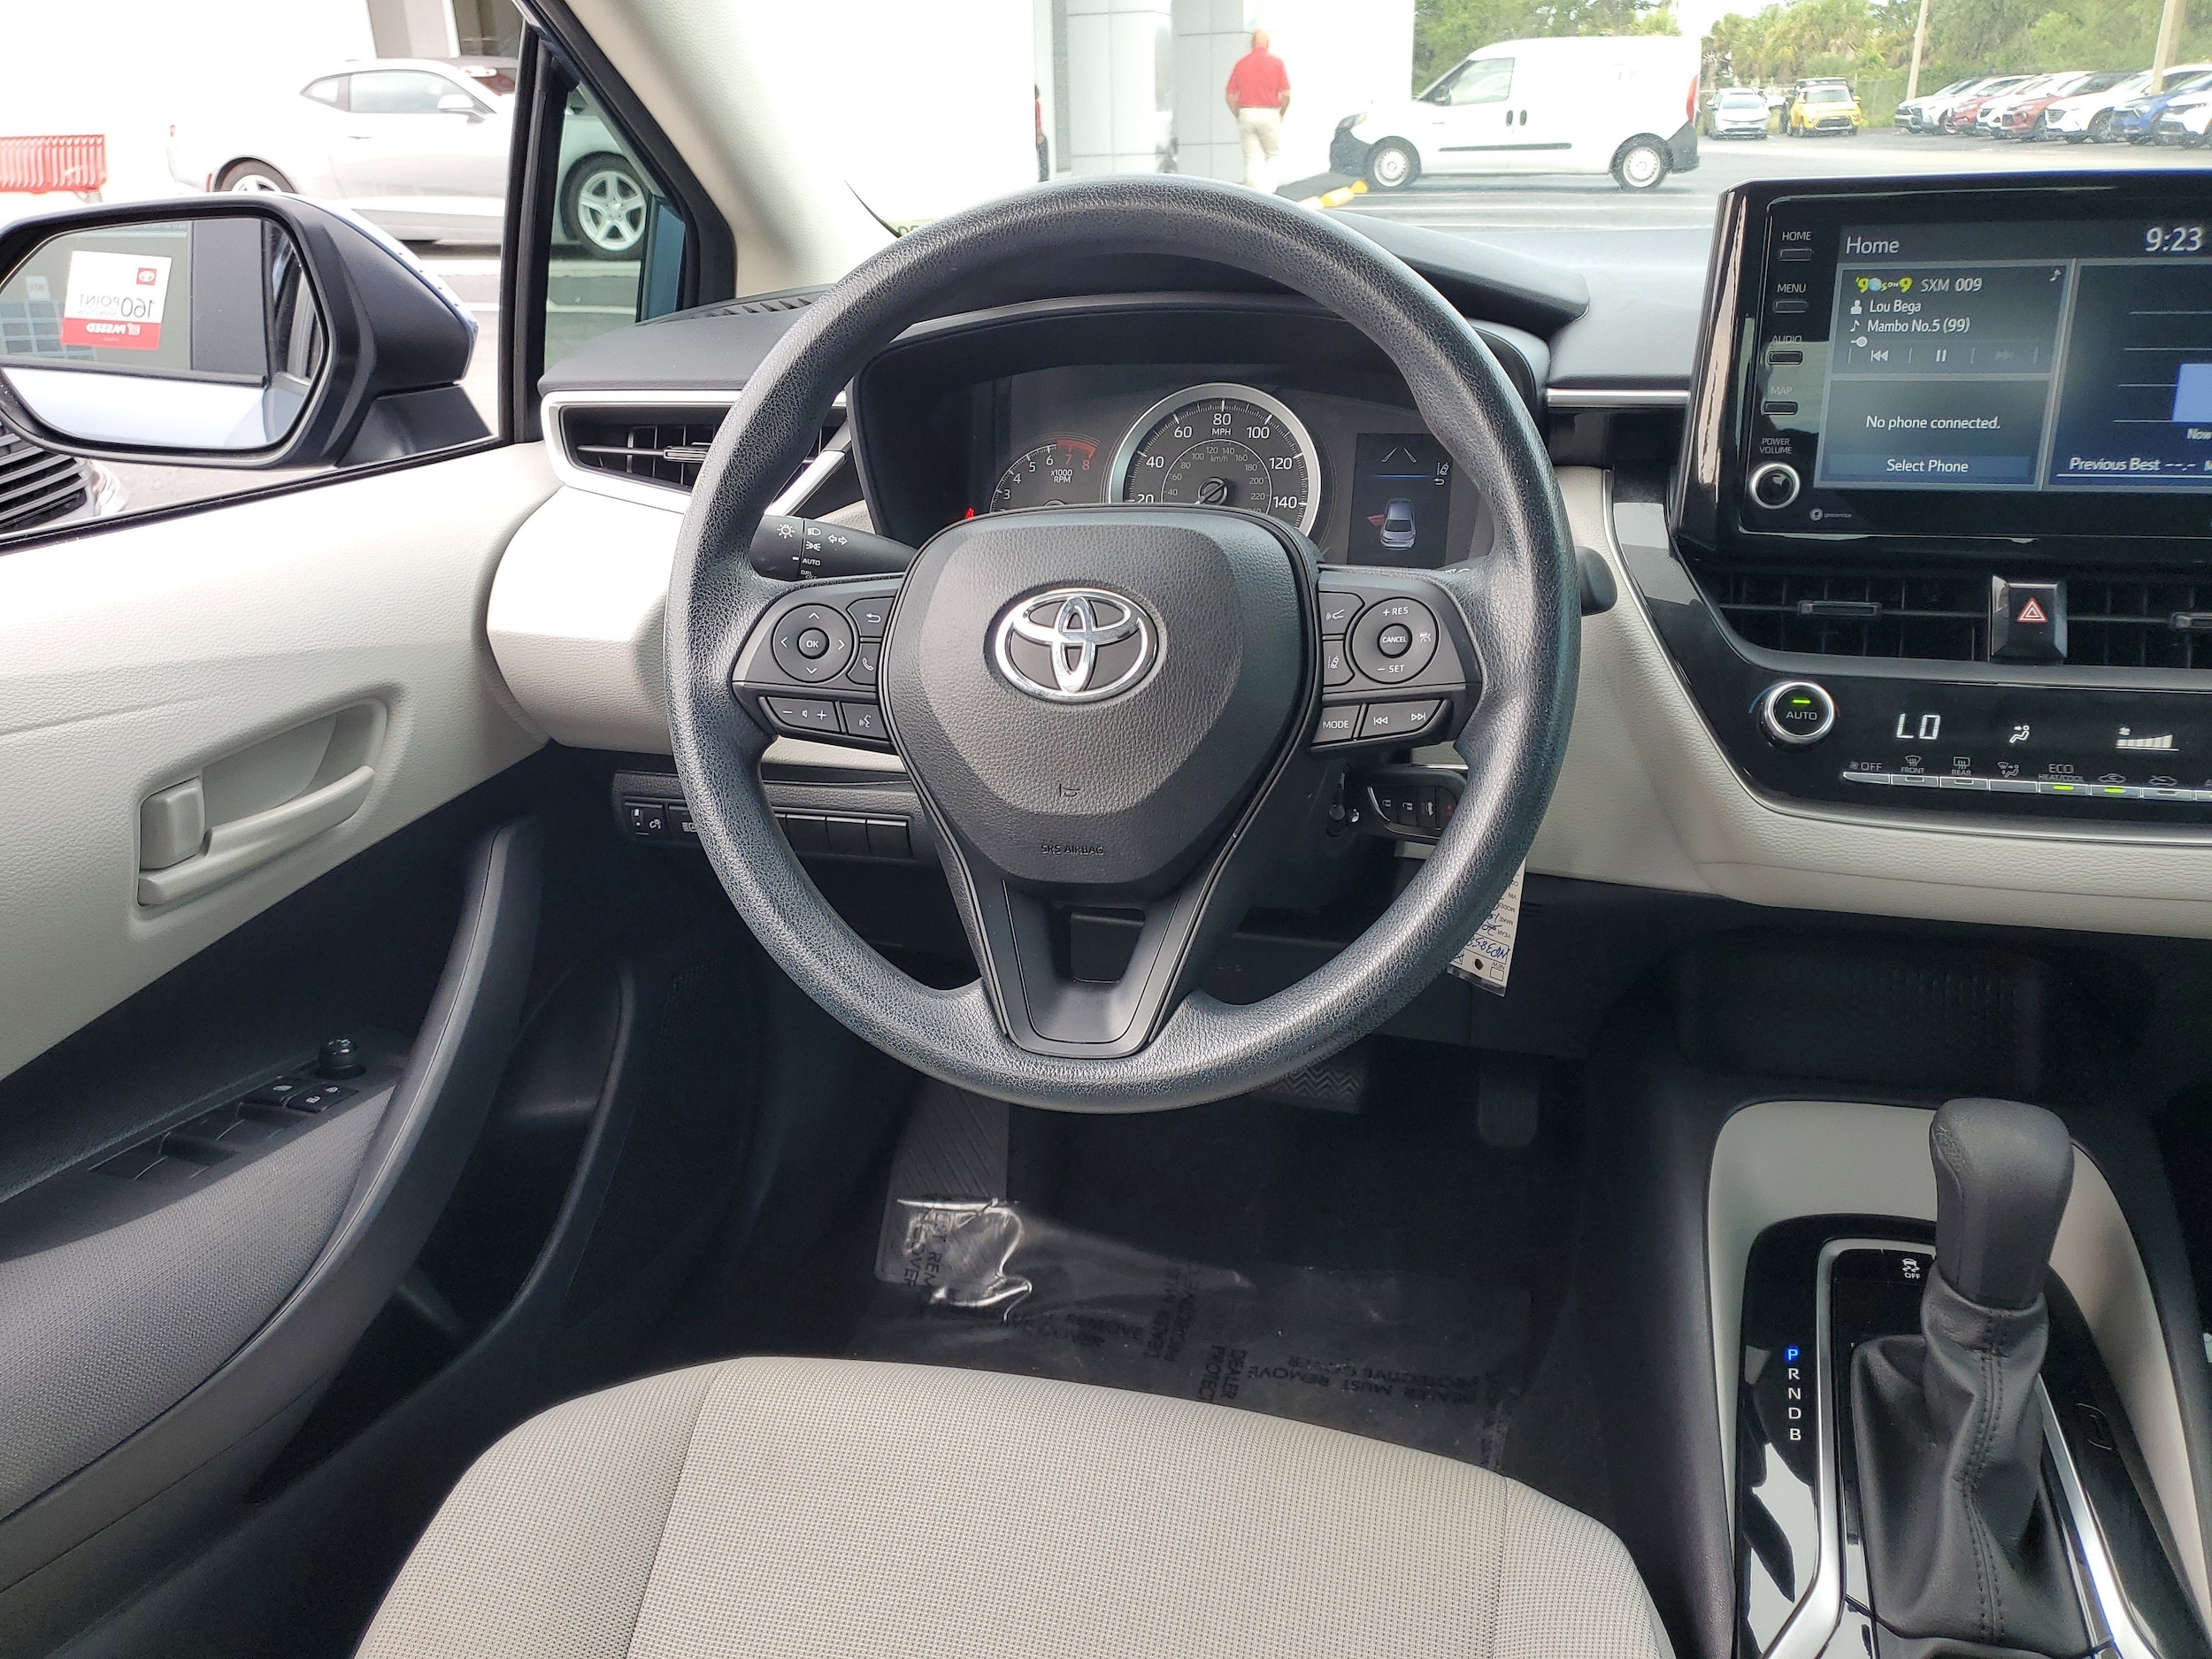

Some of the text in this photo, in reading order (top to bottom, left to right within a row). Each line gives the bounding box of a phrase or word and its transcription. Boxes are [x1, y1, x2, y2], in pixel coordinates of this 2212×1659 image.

[1781, 231, 1812, 242] HOME
[2146, 227, 2202, 251] 9:23
[1846, 236, 1900, 254] Home
[1777, 283, 1807, 294] MENU
[1920, 278, 1983, 292] SXM 009
[1870, 299, 1922, 315] Lou Bega
[1867, 317, 1970, 334] Mambo No.5 (99)
[1771, 334, 1802, 345] AUDIO
[1770, 386, 1793, 396] MAP
[1212, 413, 1232, 426] 80
[1866, 415, 2001, 431] No phone connected.
[1173, 426, 1193, 439] 60
[1246, 426, 1270, 439] 100
[1762, 437, 1791, 446] POWER
[1759, 446, 1793, 455] VOLUME
[1046, 454, 1054, 465] 6
[1065, 454, 1072, 465] 7
[1082, 459, 1090, 471] 8
[1146, 457, 1164, 468] 40
[1269, 457, 1293, 470] 120
[2069, 457, 2127, 471] Previous
[2129, 457, 2162, 471] Best
[1028, 461, 1036, 472] 5
[1886, 459, 1969, 472] Select Phone
[1012, 472, 1022, 484] 4
[1002, 488, 1011, 500] 3
[1137, 494, 1155, 503] 20
[1250, 492, 1265, 501] 220
[1273, 495, 1298, 509] 140
[1392, 607, 1409, 616] RES
[806, 640, 819, 649] OK
[1388, 664, 1405, 673] SET
[1786, 710, 1817, 721] AUTO
[1322, 720, 1349, 729] MODE
[1860, 762, 1883, 772] OFF
[2048, 764, 2074, 774] ECO
[2038, 773, 2085, 782] HEAT/COOL
[1041, 844, 1104, 856] SRS AIRBAG
[1499, 915, 1514, 926] MAKE
[1497, 928, 1511, 939] YEAR
[1493, 962, 1505, 971] NEW
[1904, 1271, 1921, 1280] OFF
[1787, 1348, 1799, 1361] P
[1247, 1365, 1331, 1387] REMOVE
[1788, 1368, 1801, 1380] R
[1340, 1379, 1393, 1396] MUST
[1788, 1387, 1801, 1400] N
[1788, 1407, 1801, 1419] D
[1789, 1427, 1801, 1440] B
